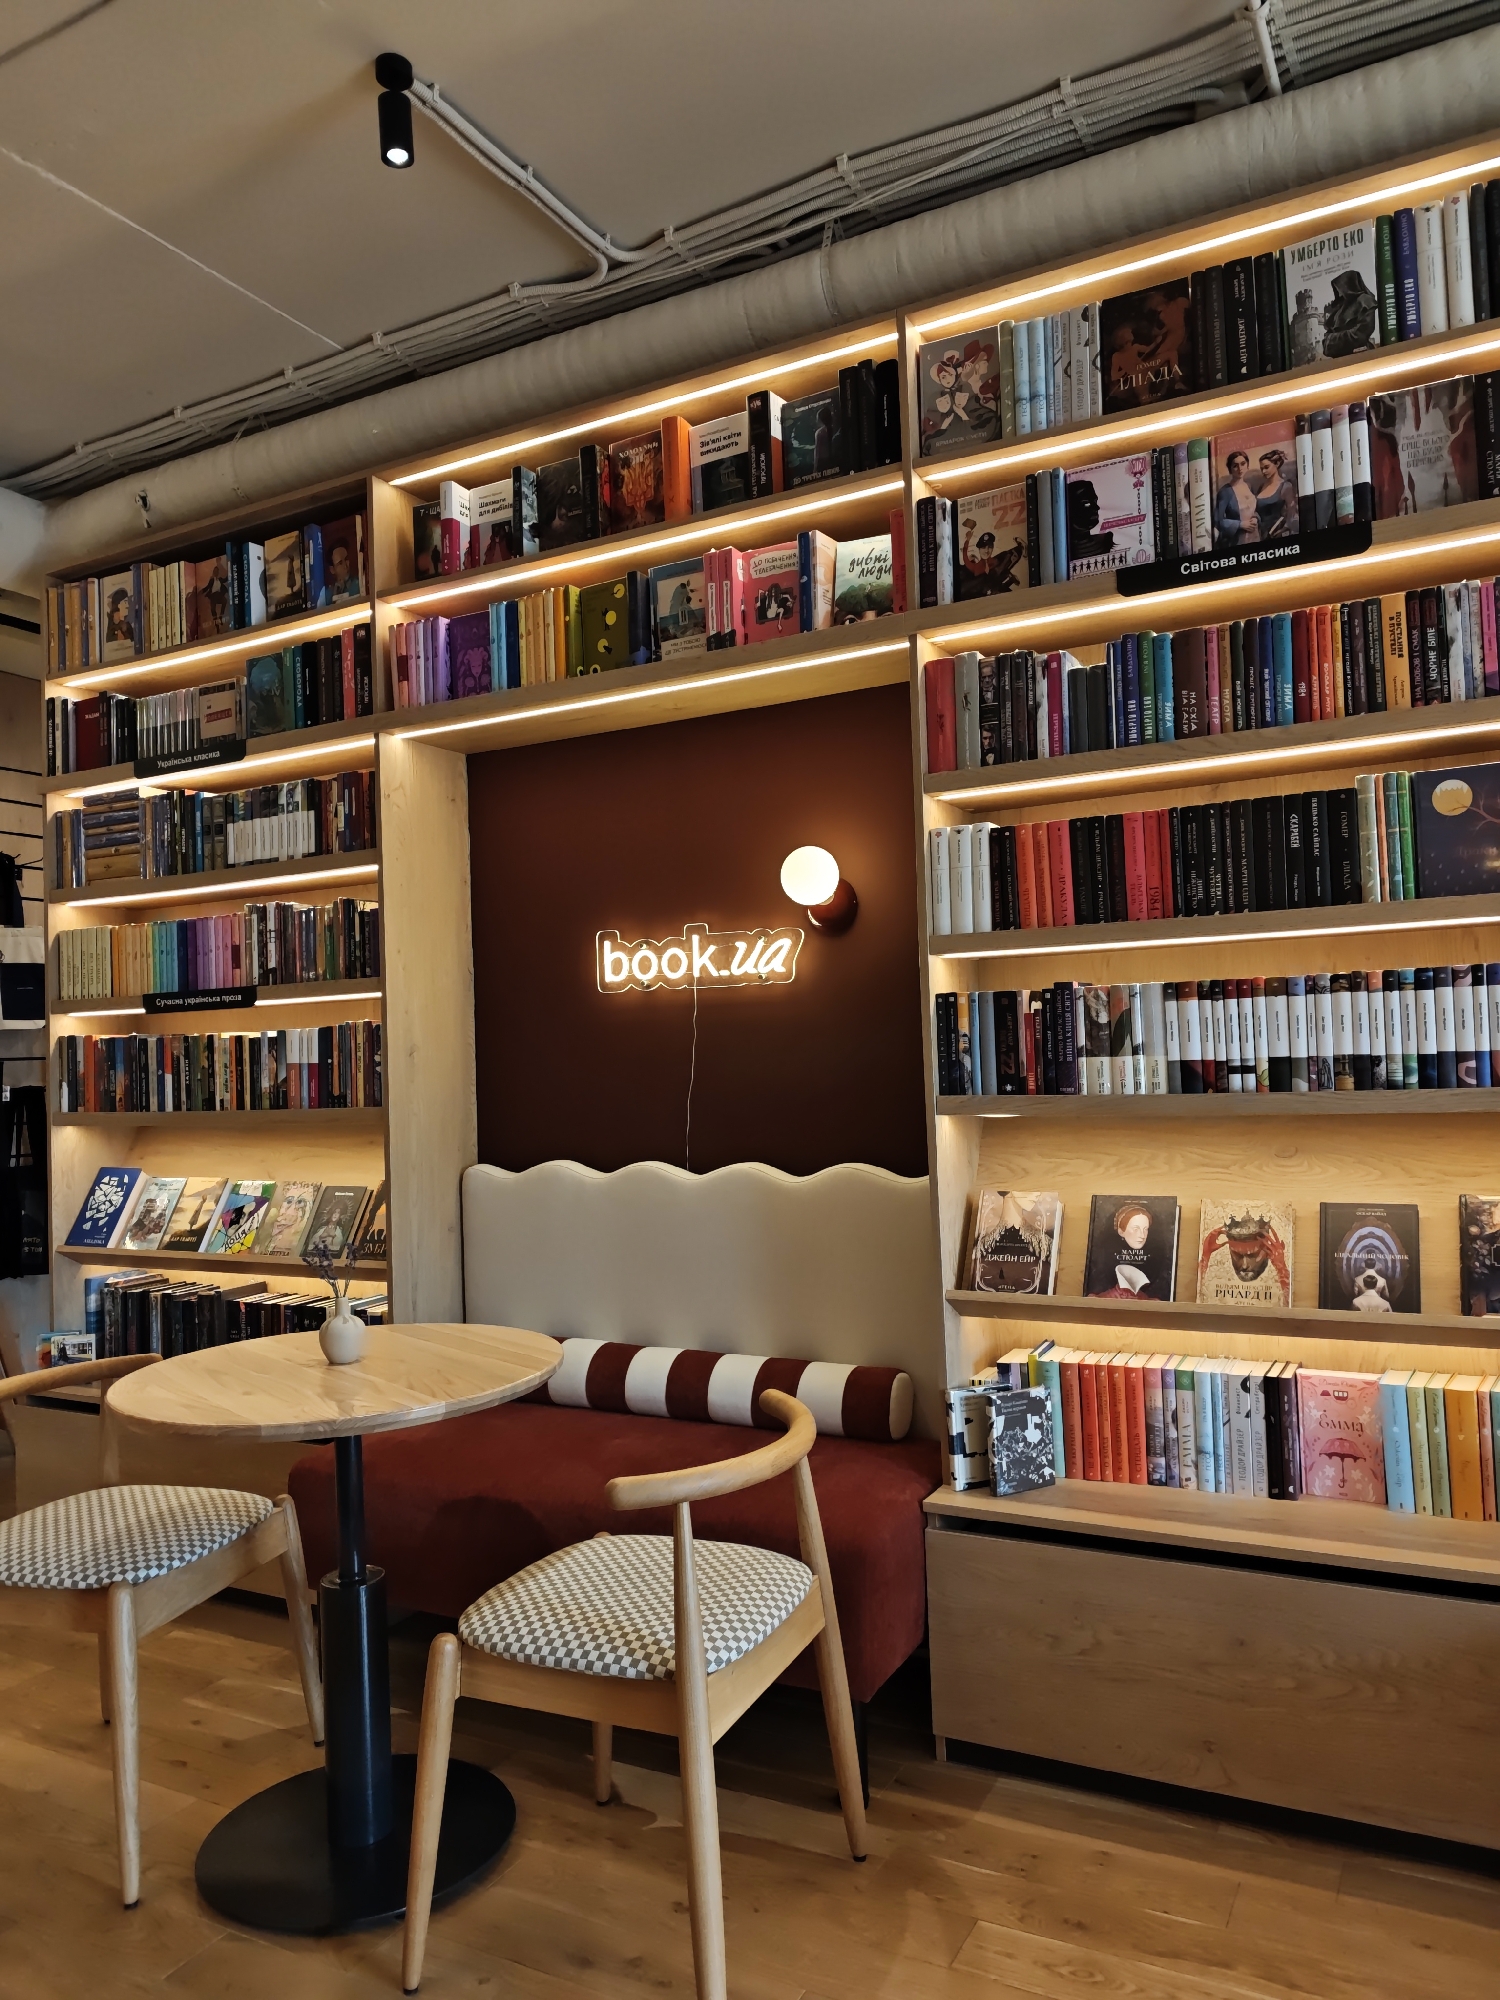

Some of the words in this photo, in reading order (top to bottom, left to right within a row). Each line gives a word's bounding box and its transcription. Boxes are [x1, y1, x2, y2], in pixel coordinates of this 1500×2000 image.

[1290, 235, 1339, 265] УМБЕРТО
[1343, 228, 1364, 249] ЕКО
[1326, 250, 1354, 264] РОЗИ
[1384, 283, 1395, 296] ЕКО
[1403, 279, 1415, 292] ЕКО
[1386, 298, 1397, 330] УМБЕРТО
[1406, 294, 1417, 325] УМБЕРТО
[1238, 317, 1247, 347] ДЖЕЙН
[1136, 359, 1162, 371] ГОМЕР
[1239, 348, 1248, 365] ЕЙР
[1076, 359, 1084, 386] ДРАЙЗЕР
[1119, 363, 1183, 391] ІЛІАДА
[700, 440, 739, 457] викидають
[722, 431, 742, 442] квіти
[935, 435, 965, 448] ЯРМАРОК
[478, 497, 507, 509] Шахмати
[478, 508, 490, 518] для
[992, 501, 1027, 530] 22
[1194, 492, 1206, 539] ЕММА
[848, 547, 890, 573] дивні
[857, 563, 893, 580] люди
[1180, 555, 1237, 575] Світова
[1241, 543, 1300, 565] класика
[683, 637, 701, 645] ТОБОЮ
[1389, 622, 1397, 656] ПУСТЕЛІ
[1396, 611, 1405, 659] ПОВСТАННЯ
[1411, 627, 1420, 651] СМАК
[1427, 627, 1437, 647] БІЛЕ
[1323, 662, 1331, 695] ВОЛОДАР
[1413, 657, 1421, 686] ЛЮБОВ
[1429, 650, 1438, 681] ЧОРНЕ
[1143, 696, 1152, 708] ЕКО
[1189, 691, 1197, 705] НА
[1283, 683, 1293, 710] ЗИМА
[1298, 681, 1306, 697] 1984
[1414, 687, 1422, 699] НА
[1127, 699, 1136, 712] ЕКО
[1164, 701, 1172, 728] ЗИМА
[1189, 706, 1198, 731] СХІД
[1211, 695, 1219, 725] ТЕАТР
[1222, 688, 1230, 723] НУДОТА
[1128, 713, 1137, 743] УМБЕРТО
[1143, 709, 1153, 739] УМБЕРТО
[1182, 706, 1190, 734] ЕДЕМУ
[156, 755, 192, 769] Українська
[193, 750, 221, 762] класика
[1289, 813, 1301, 849] СКАРАБЕЙ
[1340, 810, 1349, 839] ГОМЕР
[1058, 873, 1068, 919] ДРАКУЛА
[1149, 886, 1160, 911] 1984
[603, 933, 793, 984] book.ua
[155, 997, 183, 1007] Сучасна
[184, 995, 220, 1006] українська
[221, 993, 242, 1003] проза
[1000, 1052, 1015, 1075] 22
[984, 1253, 1018, 1263] ДЖЕЙН
[1019, 1253, 1036, 1264] ЕЙР
[1334, 1251, 1377, 1260] ІДЕАЛЬНИЙ
[1377, 1252, 1409, 1261] ЧОЛОВІК
[1215, 1290, 1262, 1301] РІЧАРД
[1318, 1409, 1365, 1438] Емма
[1134, 1432, 1142, 1473] СТЕНДАЛЬ
[1182, 1424, 1192, 1468] ЕММА
[1236, 1428, 1245, 1457] ДРАЙЗЕР
[1255, 1431, 1264, 1460] ДРАЙЗЕР
[1238, 1457, 1246, 1482] ТЕОДОР
[1256, 1460, 1265, 1484] ТЕОДОР
